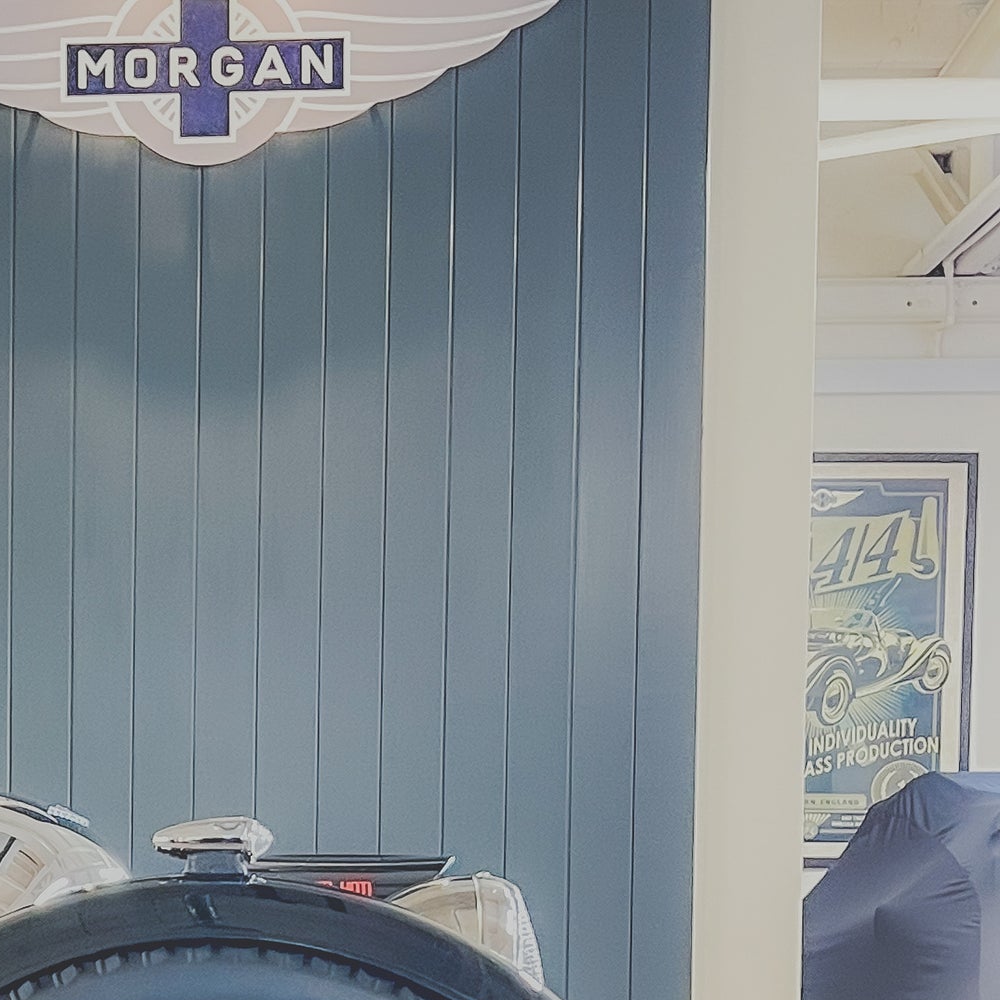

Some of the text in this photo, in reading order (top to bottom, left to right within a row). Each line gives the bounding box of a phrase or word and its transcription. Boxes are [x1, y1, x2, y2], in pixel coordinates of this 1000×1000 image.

[76, 43, 334, 90] MORGAN
[812, 516, 903, 588] 4/4
[807, 717, 918, 757] INDIVIDUALITY
[836, 736, 940, 770] PRODUCTION
